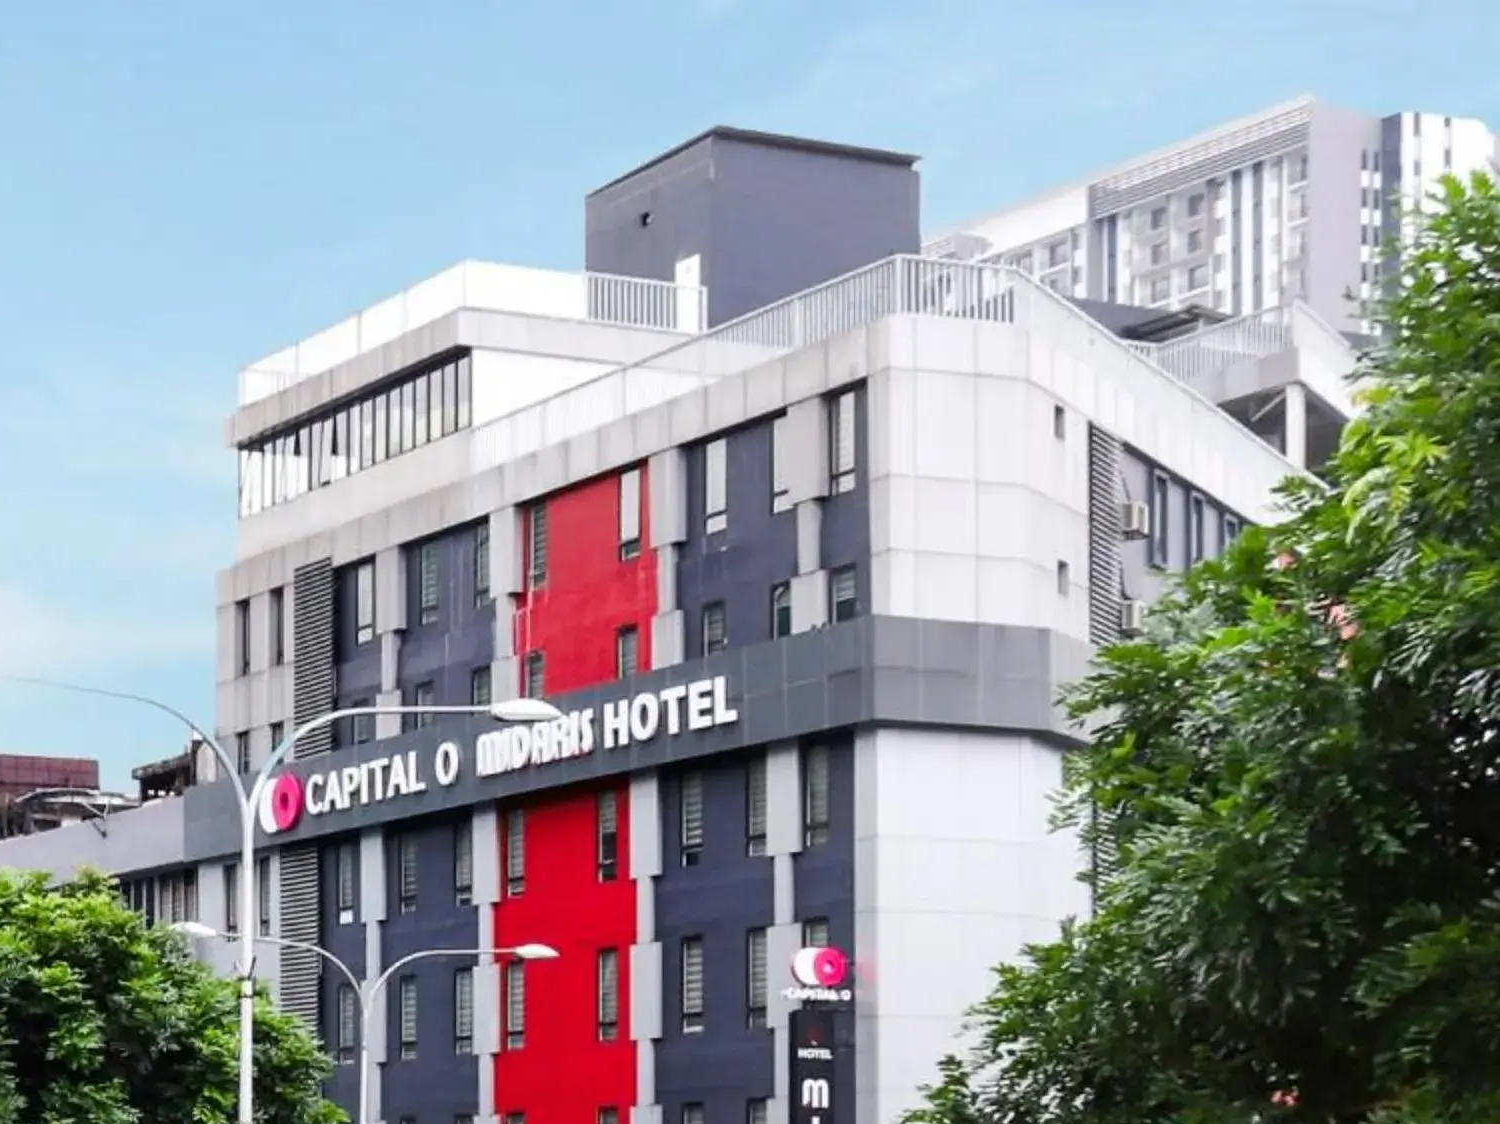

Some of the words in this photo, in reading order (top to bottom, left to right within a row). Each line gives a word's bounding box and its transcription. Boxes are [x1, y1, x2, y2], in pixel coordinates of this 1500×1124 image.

[305, 752, 427, 815] CAPITAL
[436, 741, 459, 784] O
[476, 708, 594, 777] MIDARIS
[604, 675, 738, 749] HOTEL
[797, 1047, 833, 1060] HOTEL
